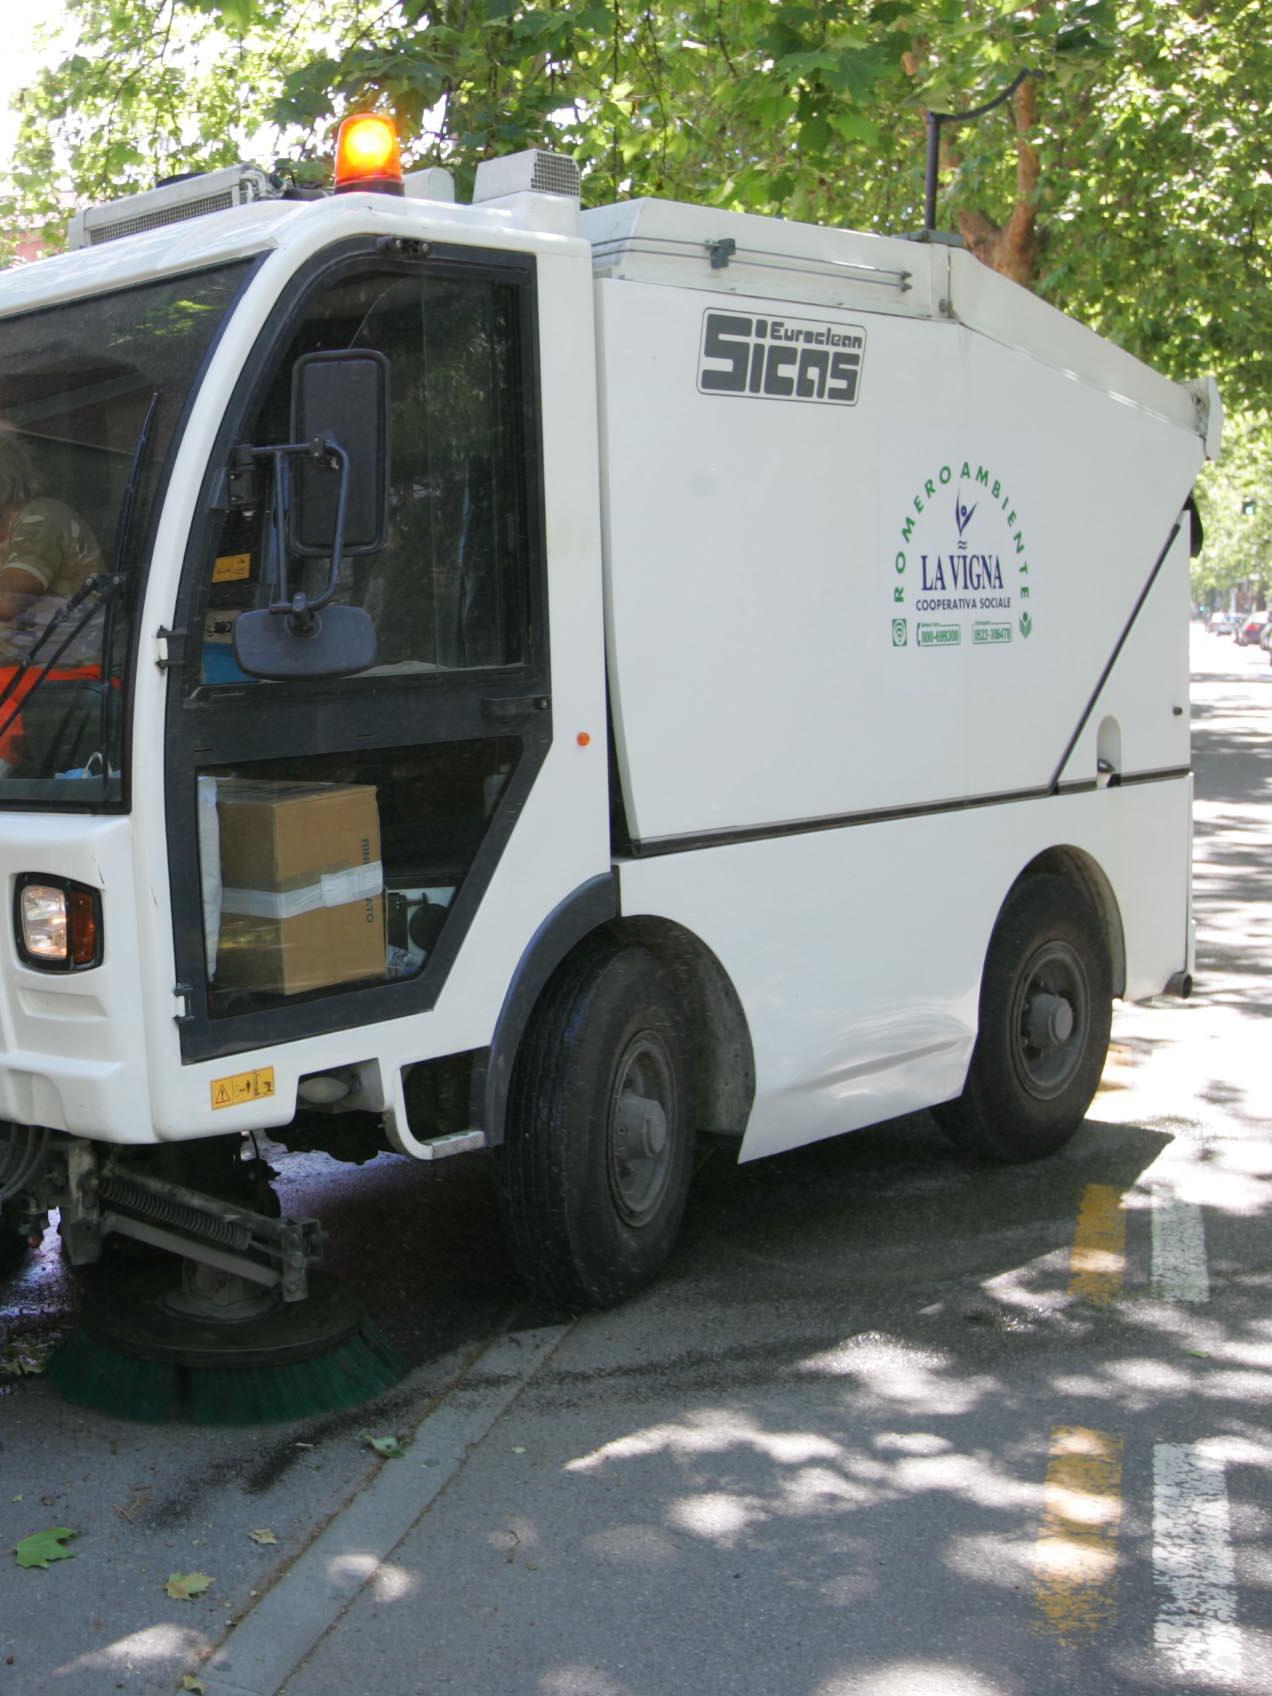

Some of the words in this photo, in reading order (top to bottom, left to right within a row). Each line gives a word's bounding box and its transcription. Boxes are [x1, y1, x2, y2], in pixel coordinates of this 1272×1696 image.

[770, 321, 862, 349] Euroclean
[920, 554, 946, 591] LA
[948, 554, 1004, 591] VIGNA
[915, 597, 977, 612] COOPERATIVA
[979, 596, 1011, 610] SOCIALE
